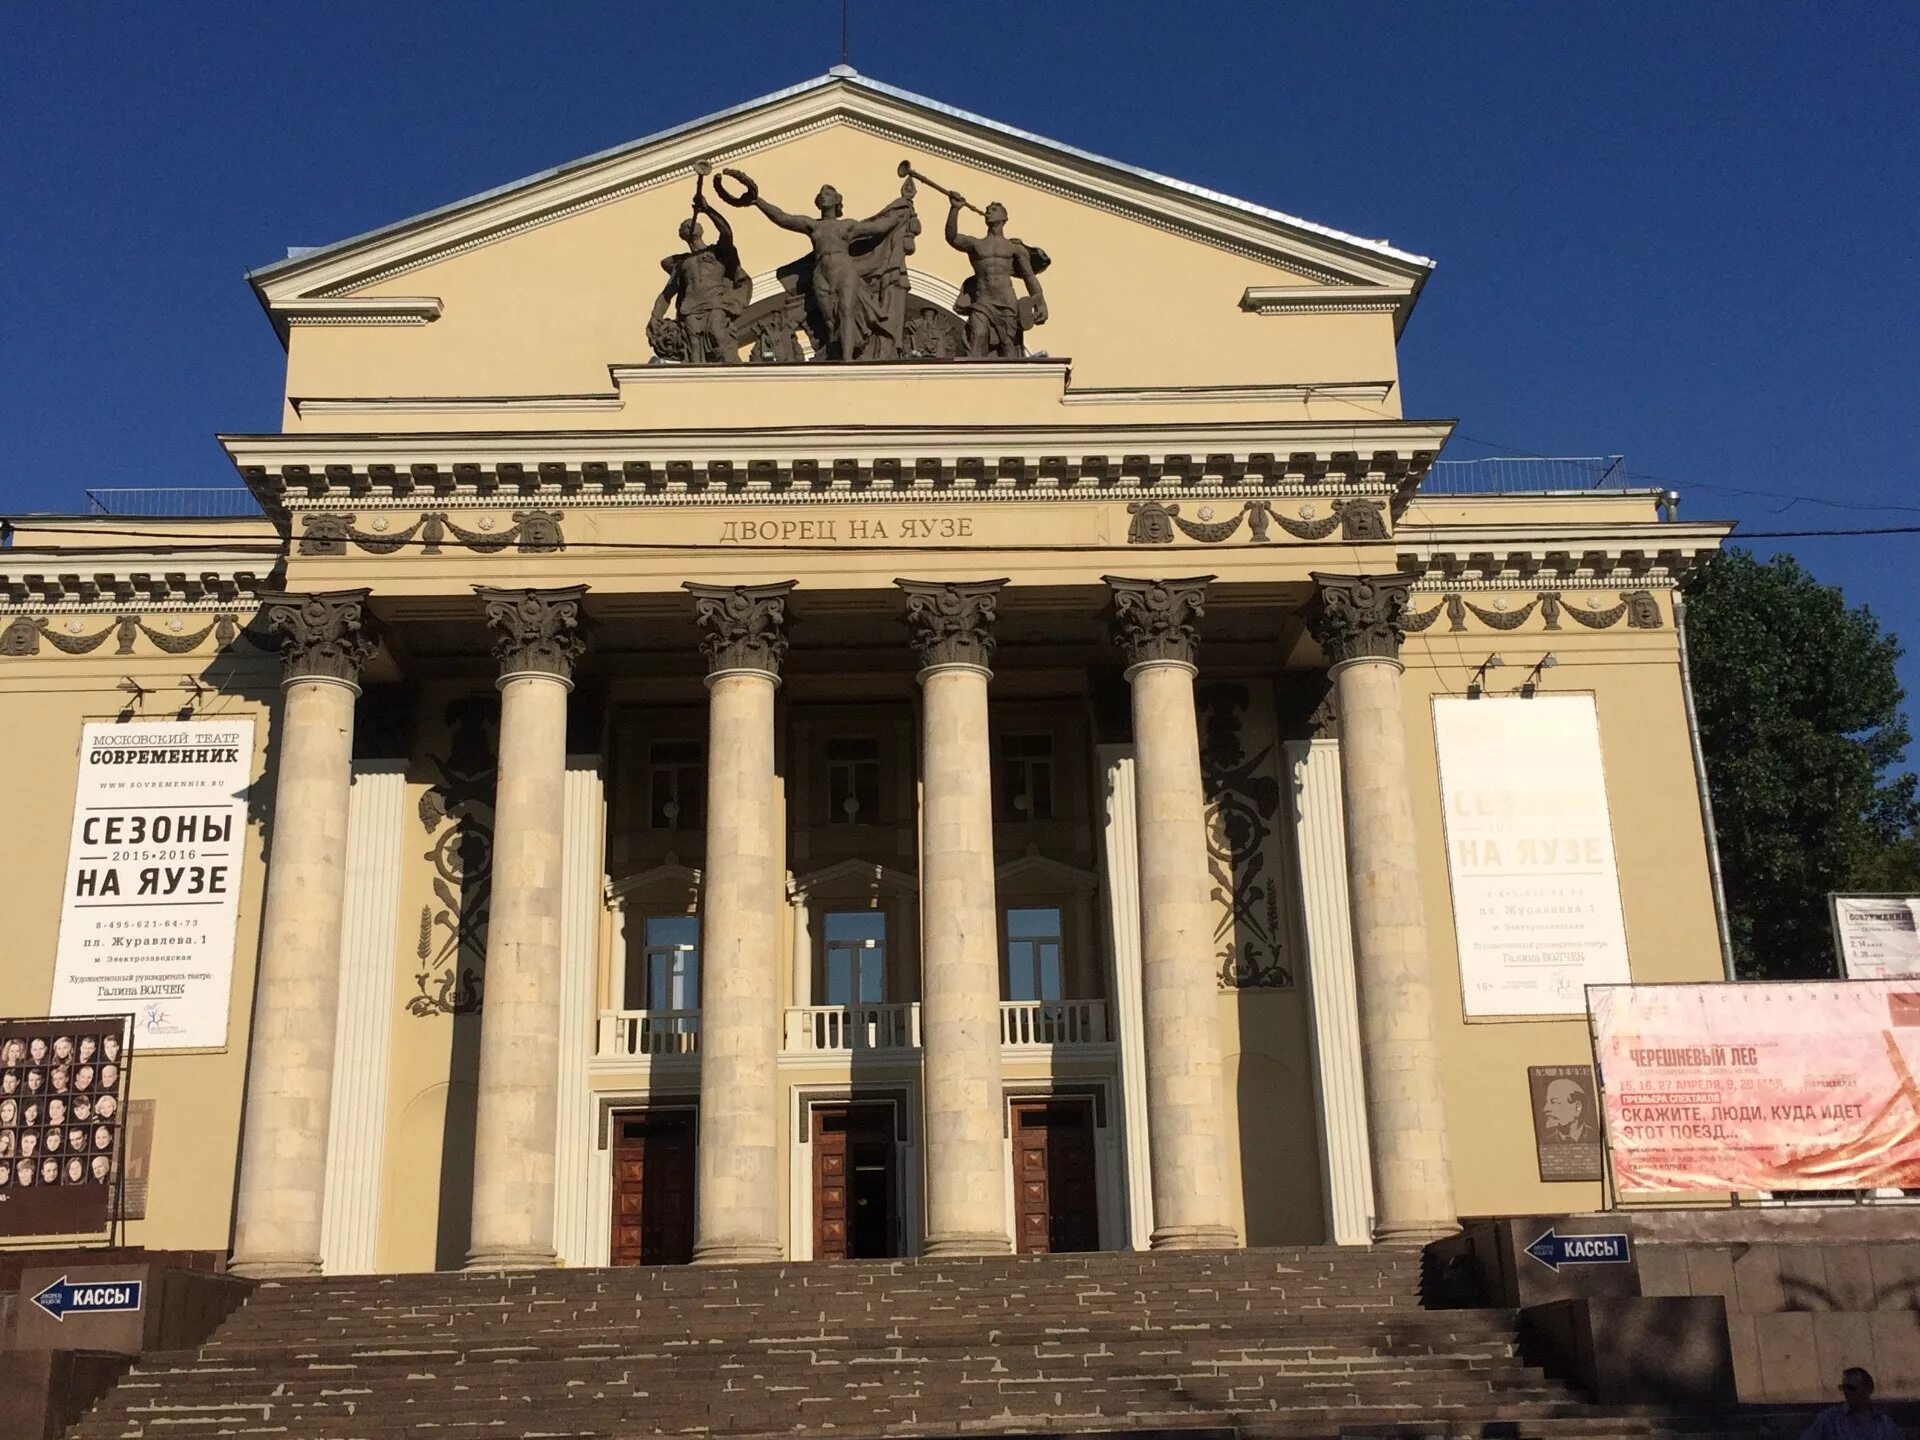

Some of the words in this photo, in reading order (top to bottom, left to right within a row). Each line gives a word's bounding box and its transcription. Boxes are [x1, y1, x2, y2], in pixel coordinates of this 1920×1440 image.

[719, 520, 838, 545] ДВОРЕЦ
[848, 519, 889, 540] НА
[899, 517, 974, 538] ЯУЗЕ
[93, 732, 189, 746] МОСКОВСКИЙ
[195, 733, 240, 744] ТЕАТР
[90, 748, 239, 765] СОВРЕМЕННИК
[83, 814, 232, 845] СЕЗОНЫ
[1458, 839, 1503, 867] НА
[1516, 837, 1604, 866] ЯУЗЕ
[76, 868, 121, 897] НА
[137, 866, 228, 895] ЯУЗЕ
[107, 954, 192, 964] Электрозаводская
[97, 986, 138, 997] Галина
[140, 984, 185, 995] ВОЛЧЕК
[1630, 1047, 1726, 1068] ЧЕРЕШНЕВЫЙ
[1731, 1047, 1758, 1066] ЛЕС
[1623, 1094, 1667, 1104] ПРЕМЬЕРА
[1621, 1107, 1706, 1122] СКАЖИТЕ,
[1711, 1106, 1768, 1122] ЛЮДИ,
[1771, 1105, 1817, 1121] КУДА
[1820, 1104, 1863, 1120] ИДЕТ
[1623, 1124, 1665, 1139] ЭТОТ
[1670, 1124, 1739, 1140] ПОЕЗД...
[1564, 1240, 1619, 1258] КАССЫ
[72, 1287, 131, 1306] КАССЫ
